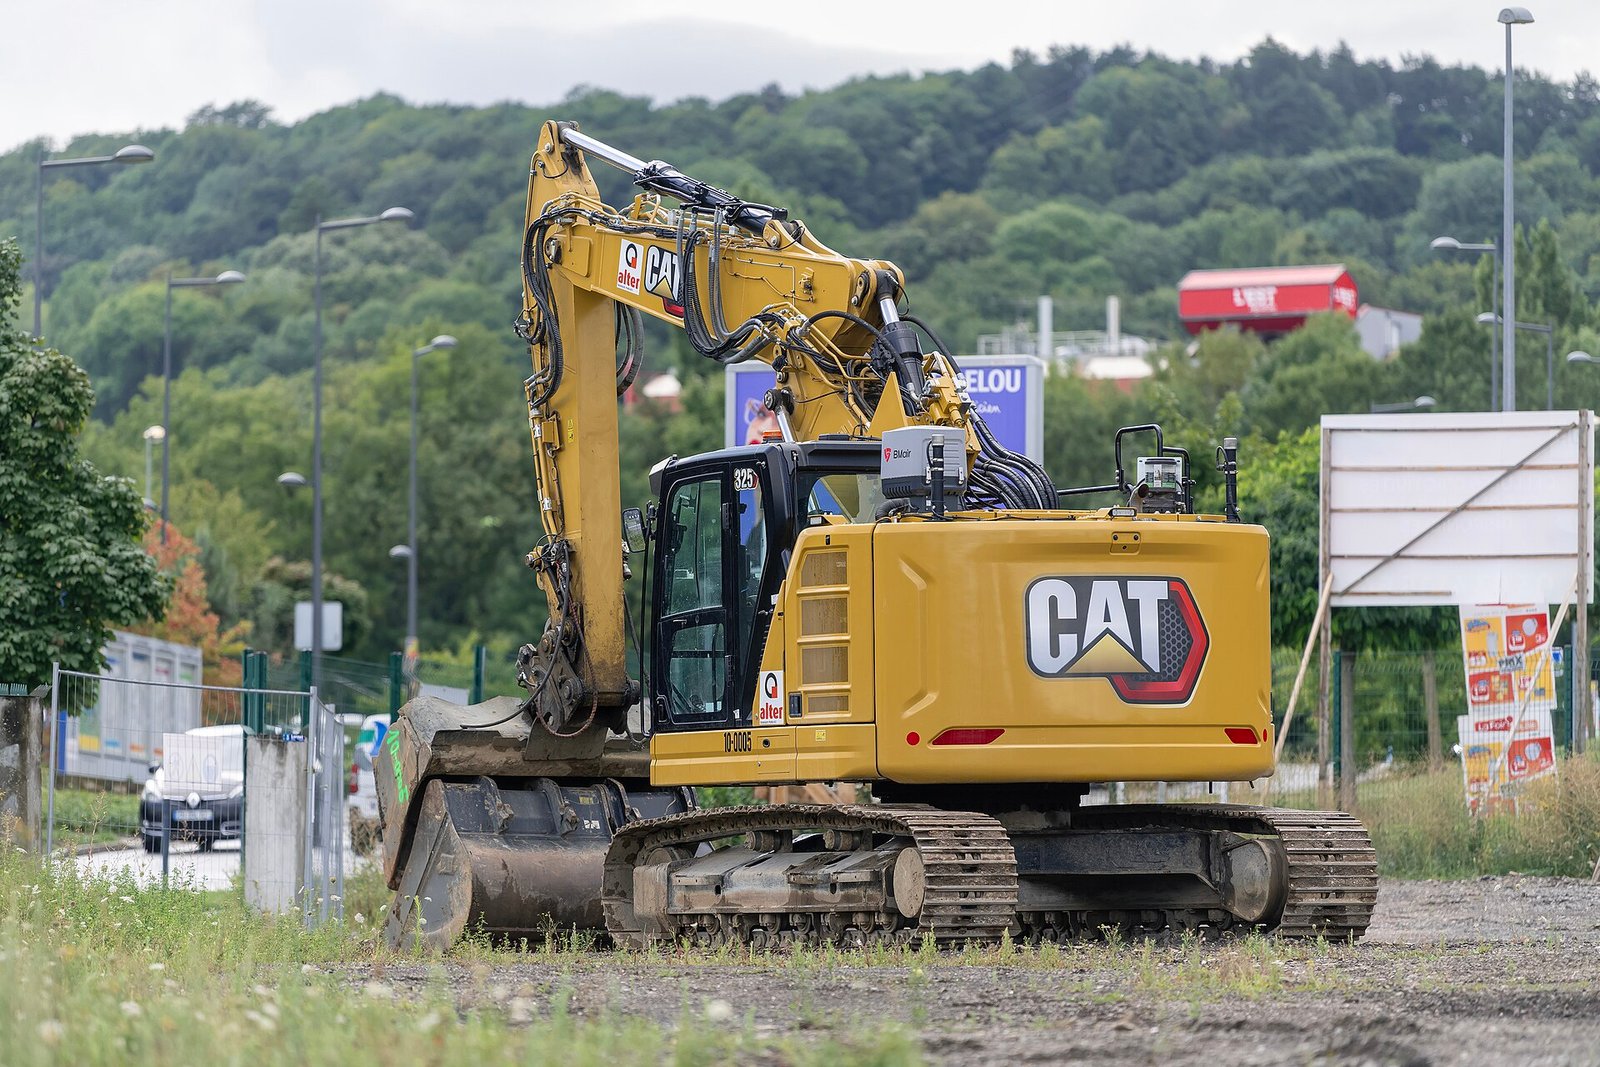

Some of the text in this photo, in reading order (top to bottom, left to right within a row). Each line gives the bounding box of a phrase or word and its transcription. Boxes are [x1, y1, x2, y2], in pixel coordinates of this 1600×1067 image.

[617, 269, 640, 289] alter
[644, 246, 680, 302] CAT
[893, 449, 911, 459] BMair
[735, 468, 753, 488] 325
[1028, 578, 1169, 674] CAT
[760, 702, 783, 720] alter
[723, 731, 752, 752] 10-0005
